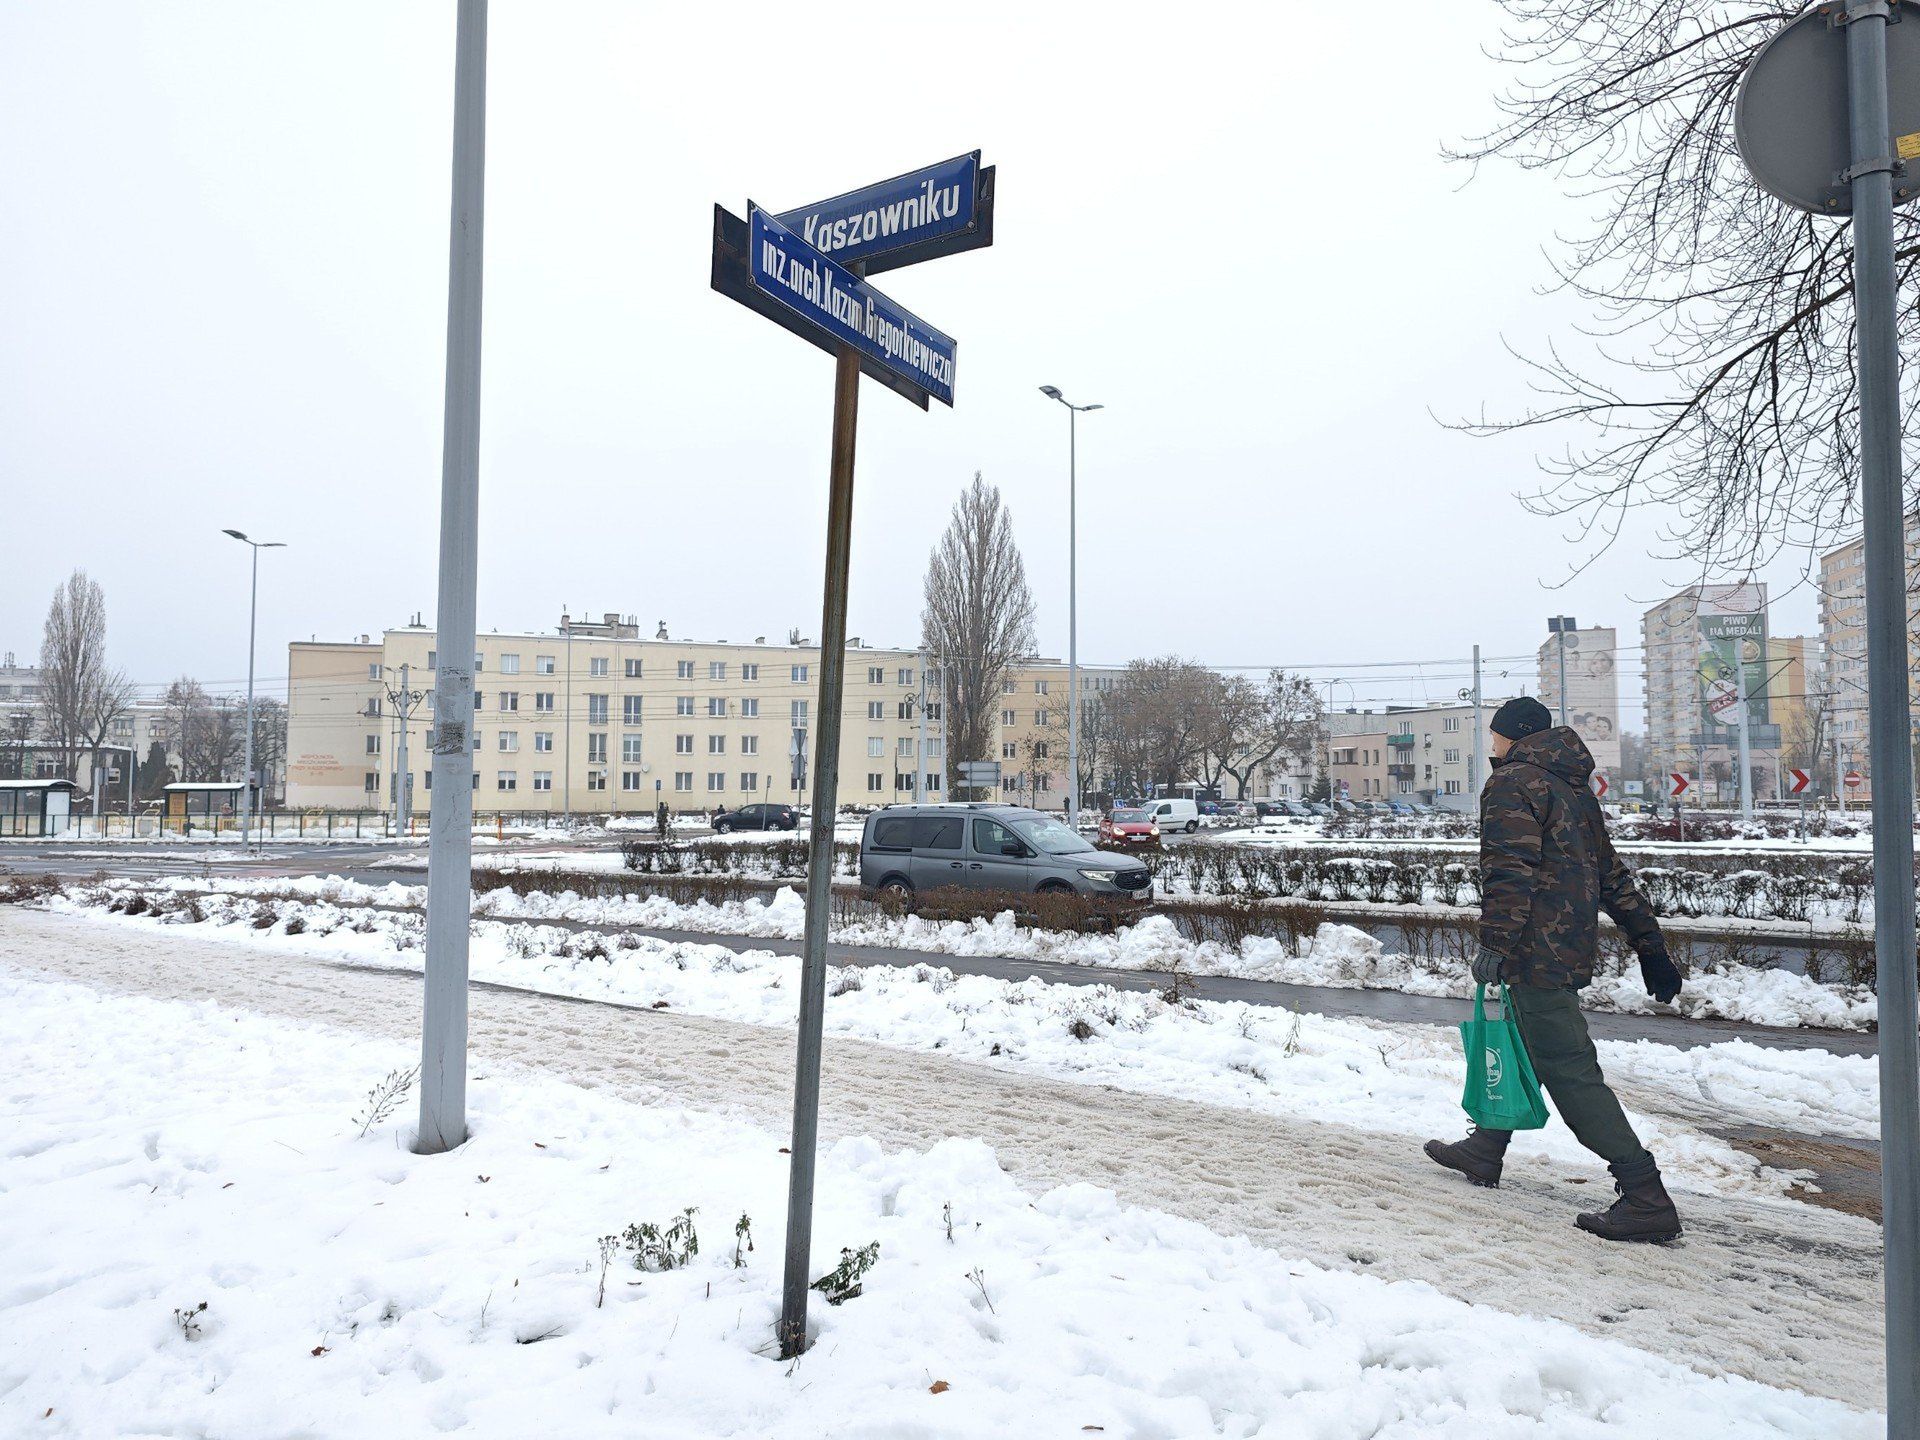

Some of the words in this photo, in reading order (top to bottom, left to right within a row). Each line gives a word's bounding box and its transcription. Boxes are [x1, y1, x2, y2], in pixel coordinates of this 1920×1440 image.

[804, 179, 960, 253] Kaszowniku
[1723, 616, 1748, 625] PIWO
[1709, 627, 1724, 636] NA
